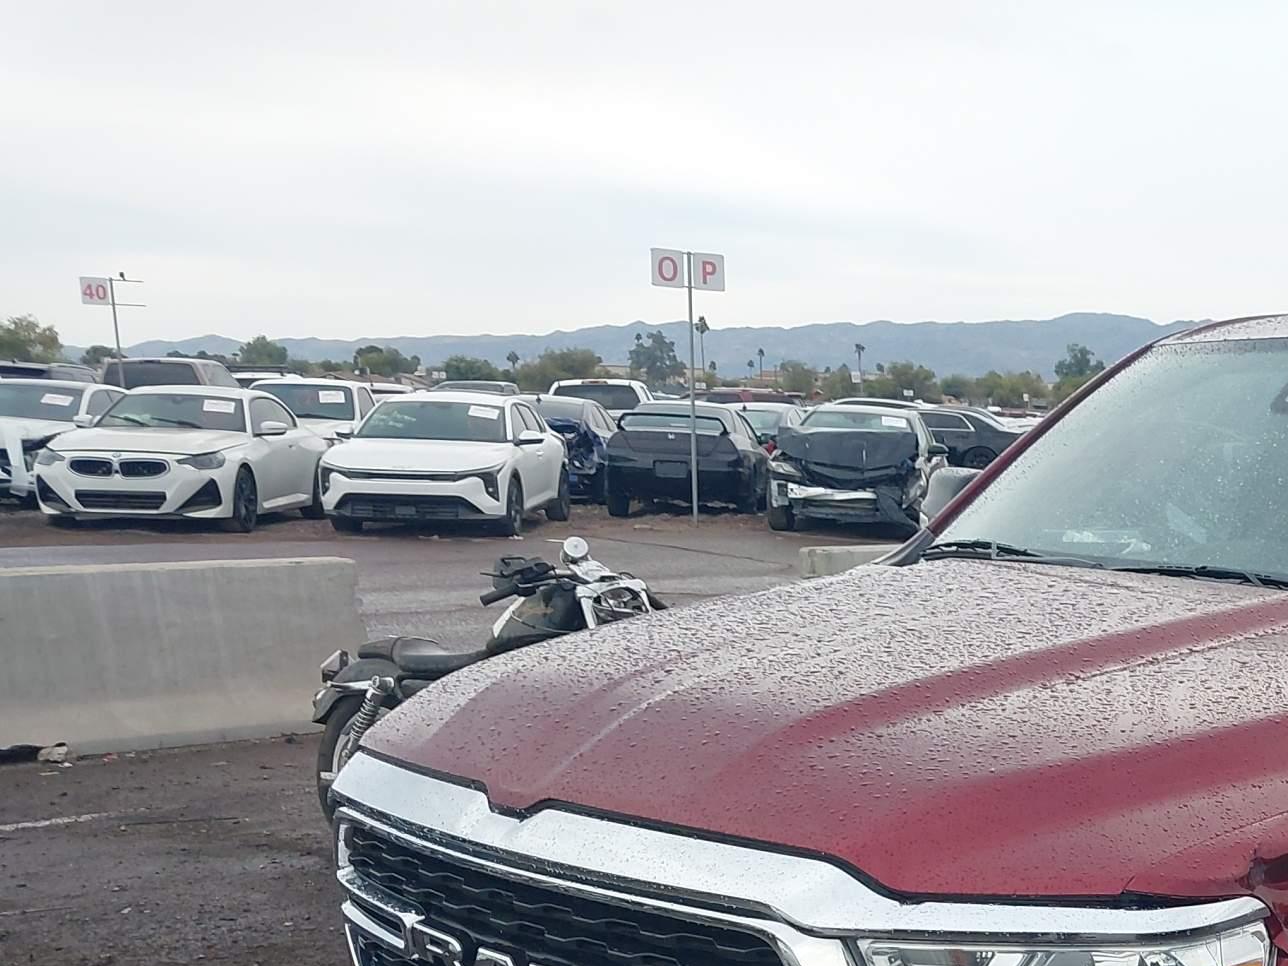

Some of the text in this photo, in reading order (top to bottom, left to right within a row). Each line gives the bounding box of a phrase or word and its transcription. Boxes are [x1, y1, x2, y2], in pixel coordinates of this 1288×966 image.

[658, 256, 678, 282] O
[702, 260, 717, 285] P
[83, 284, 107, 300] 40
